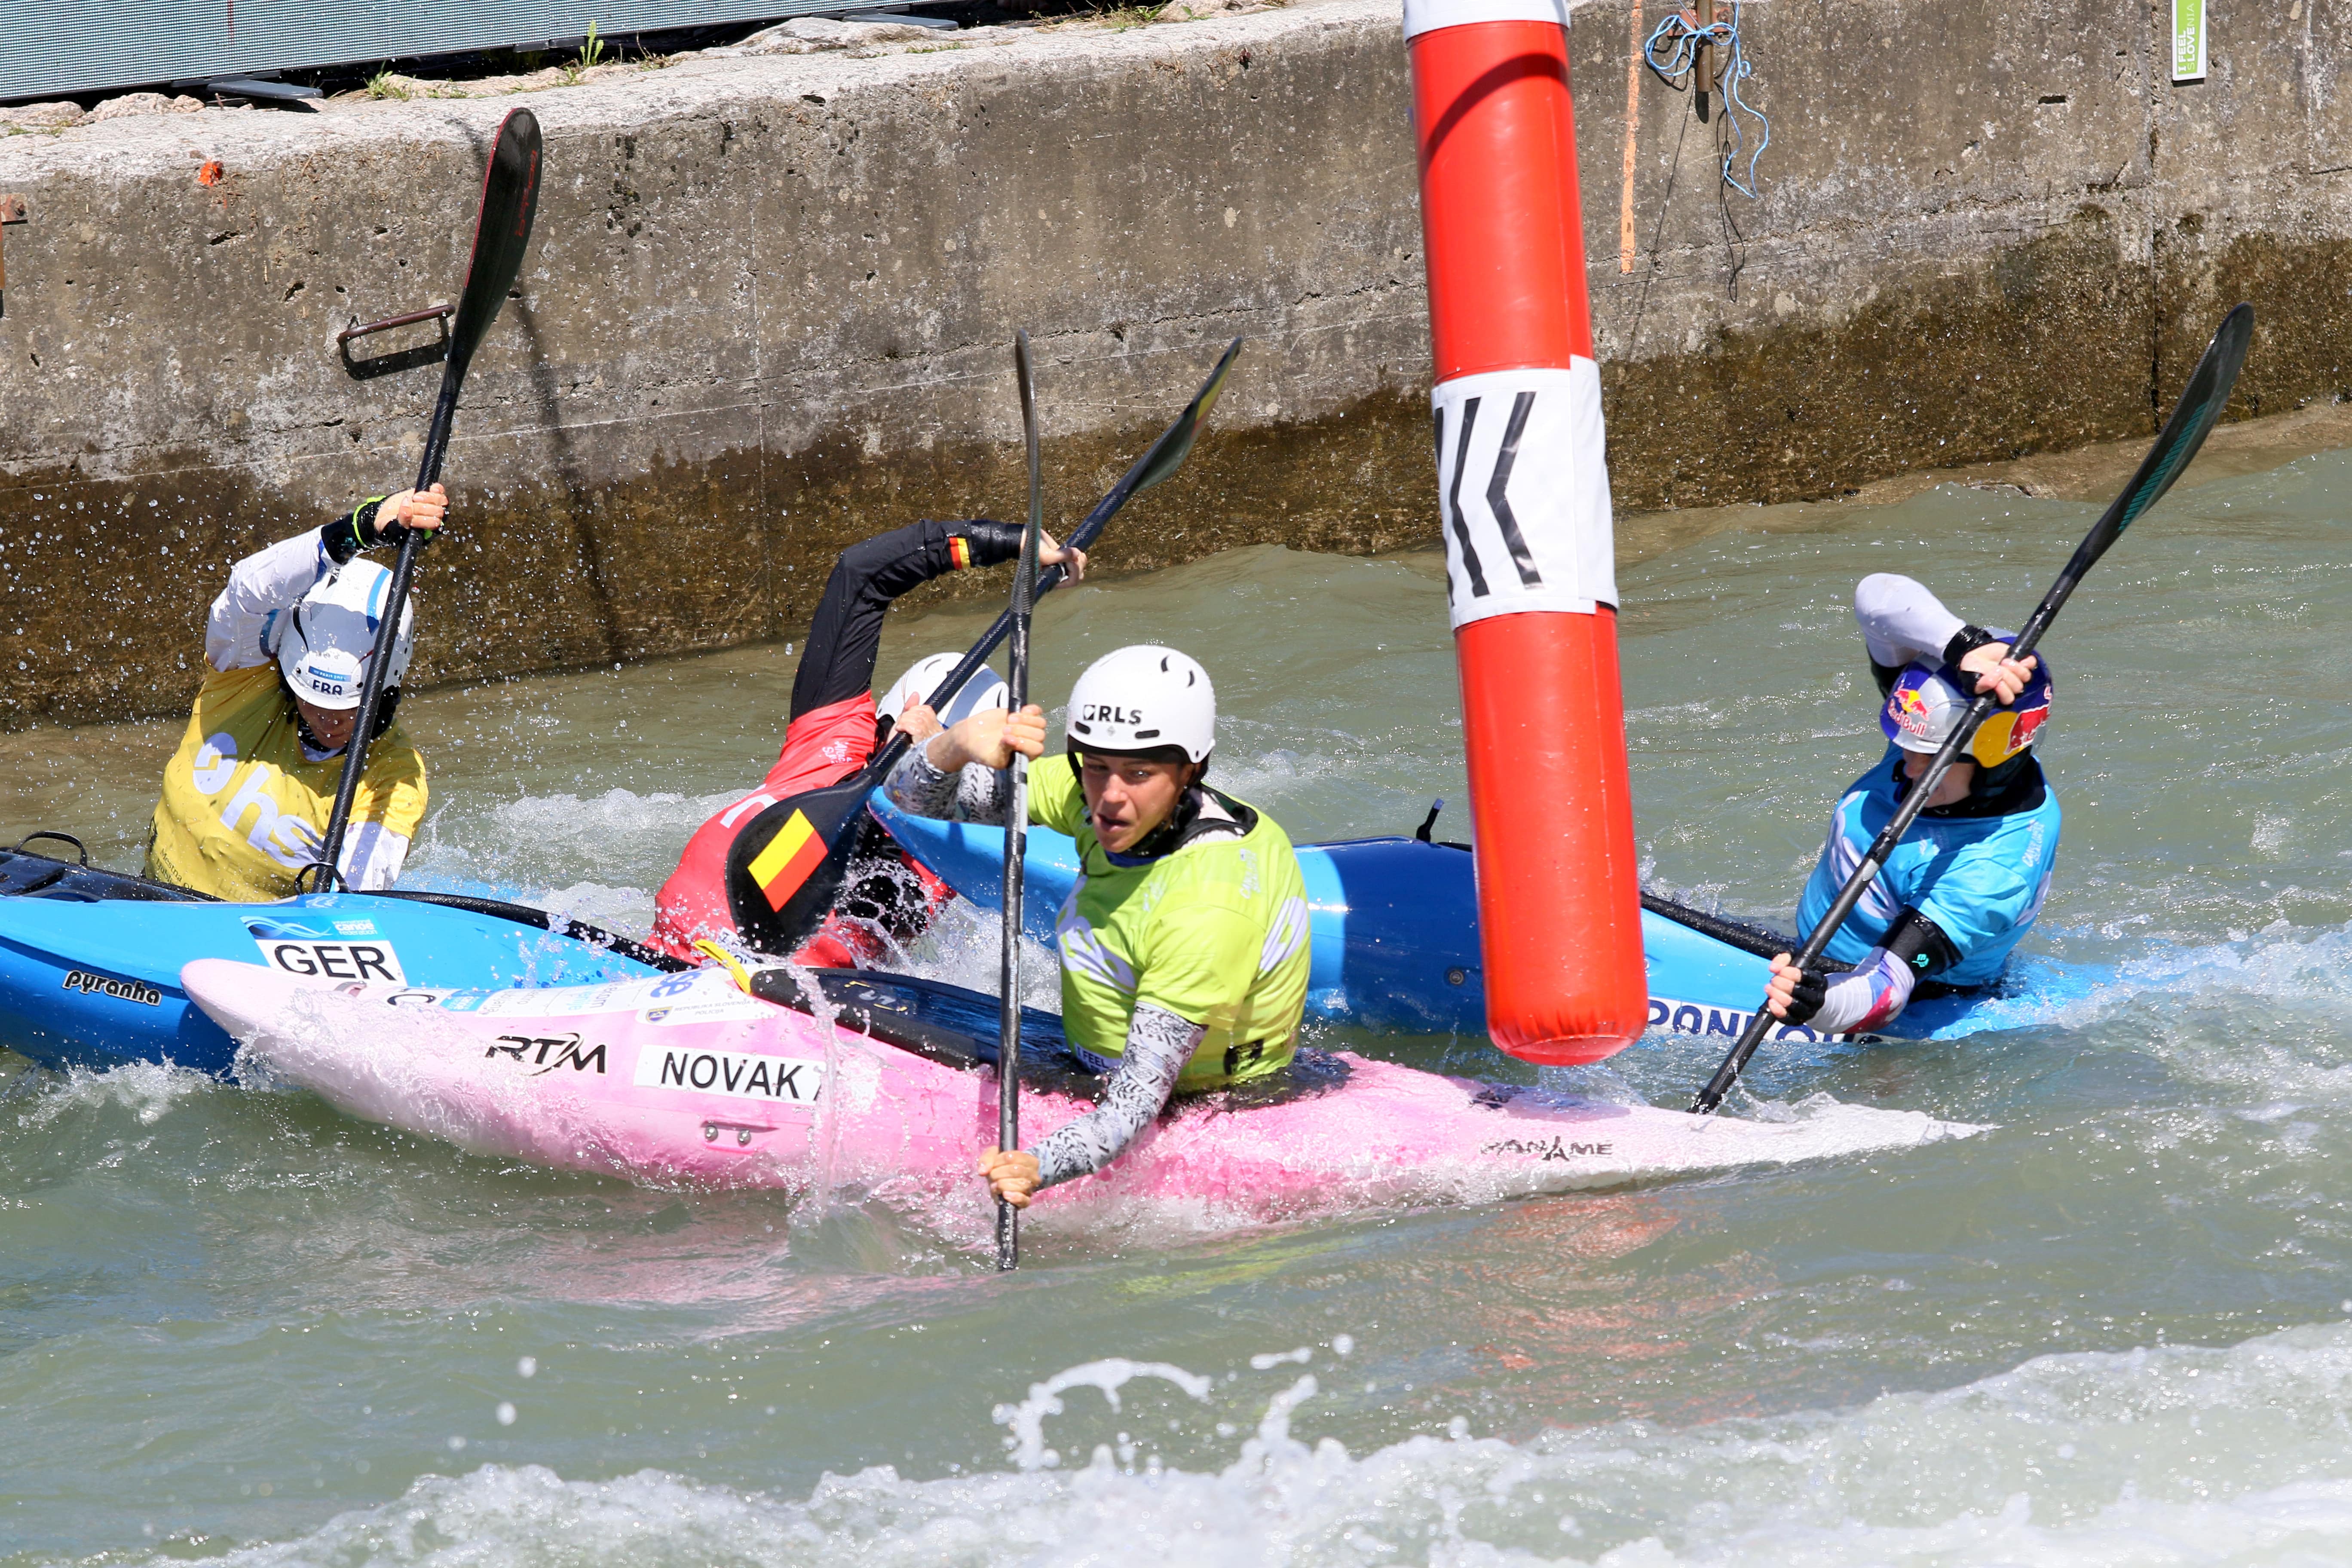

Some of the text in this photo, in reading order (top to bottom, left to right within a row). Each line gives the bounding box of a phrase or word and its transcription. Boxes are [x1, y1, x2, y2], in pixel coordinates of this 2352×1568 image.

[2178, 30, 2187, 63] FEEL
[2187, 3, 2195, 70] SLOVENIA
[312, 679, 343, 695] FRA
[1098, 705, 1142, 725] RLS
[1888, 698, 1927, 737] Red Bull
[160, 848, 182, 882] Mestna
[335, 922, 375, 931] canoe
[274, 944, 397, 981] GER
[62, 970, 162, 1006] pyranha
[674, 1003, 713, 1012] REPUBLIKA
[484, 1032, 606, 1076] RTM
[1082, 1050, 1109, 1069] FEEL
[661, 1051, 803, 1099] NOVAK
